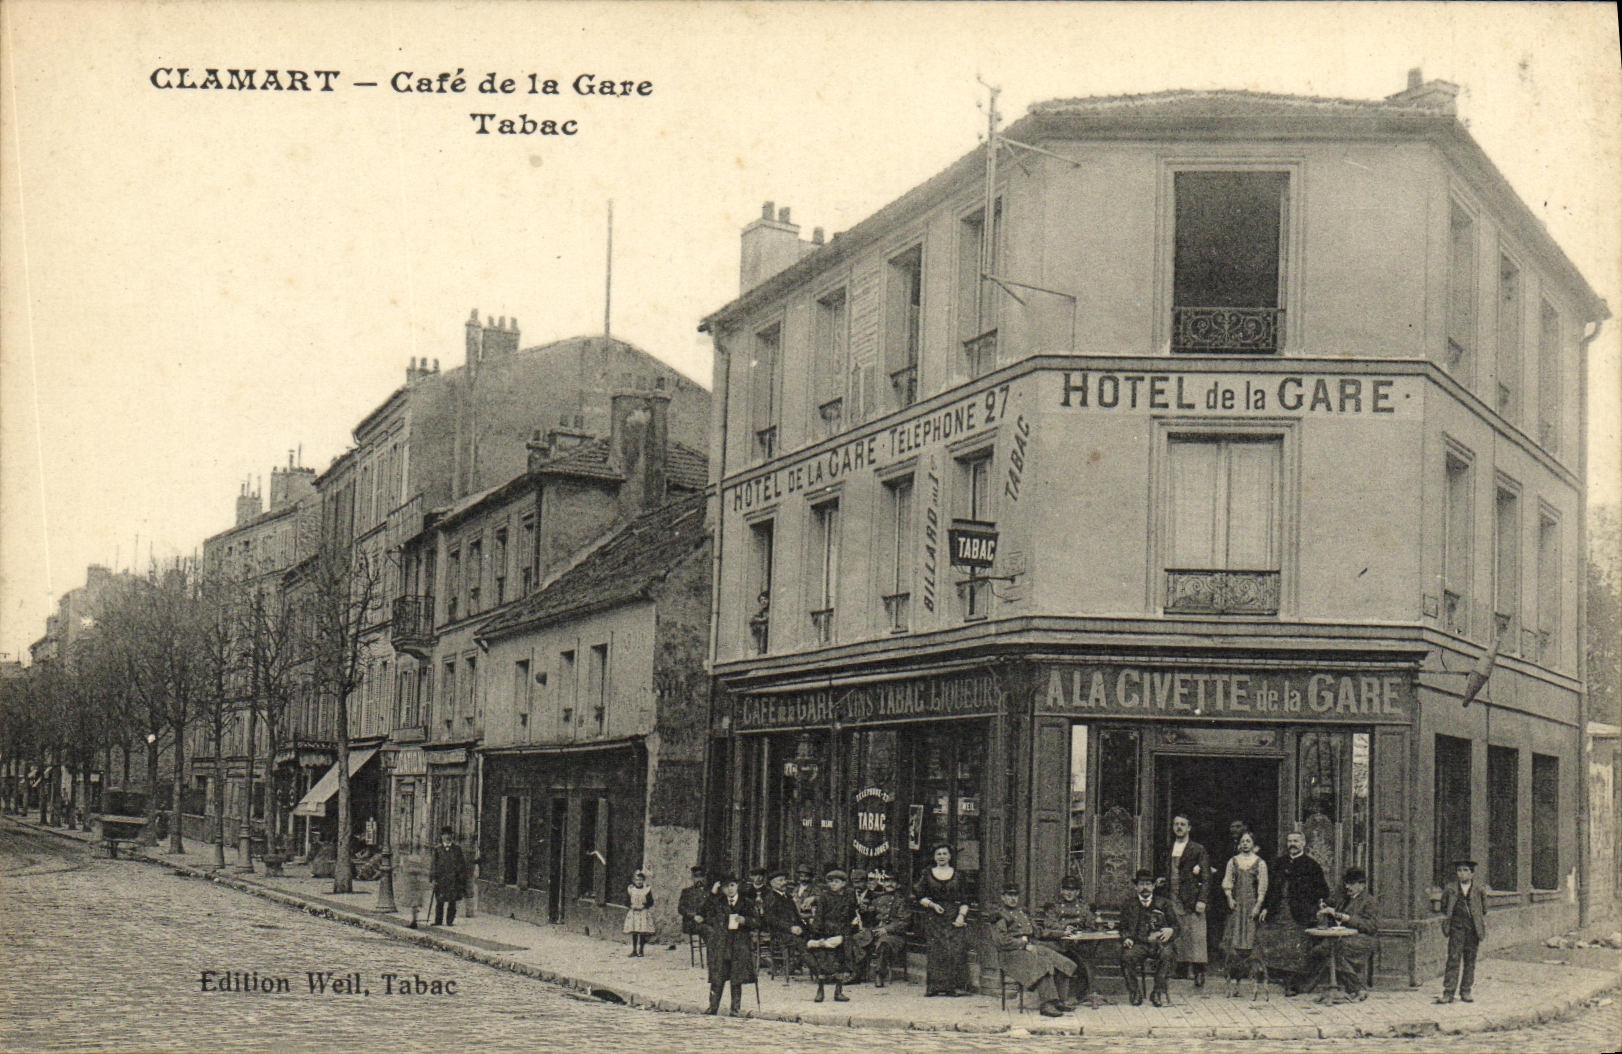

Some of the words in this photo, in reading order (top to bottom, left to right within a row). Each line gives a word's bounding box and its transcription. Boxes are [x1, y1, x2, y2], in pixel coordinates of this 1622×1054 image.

[1206, 380, 1235, 410] de
[1245, 380, 1266, 411] la
[1277, 376, 1395, 413] GARE
[787, 467, 803, 493] DE
[808, 461, 823, 487] LA
[984, 384, 1010, 424] 27
[1004, 414, 1029, 502] TABAC
[923, 507, 938, 612] BILLARD
[958, 537, 995, 561] TABAC
[1072, 670, 1107, 709] LA
[1116, 668, 1251, 711] CIVETTE
[1256, 679, 1278, 712] de
[1284, 679, 1301, 713] la
[1307, 673, 1403, 714] GARE
[858, 812, 886, 832] TABAC
